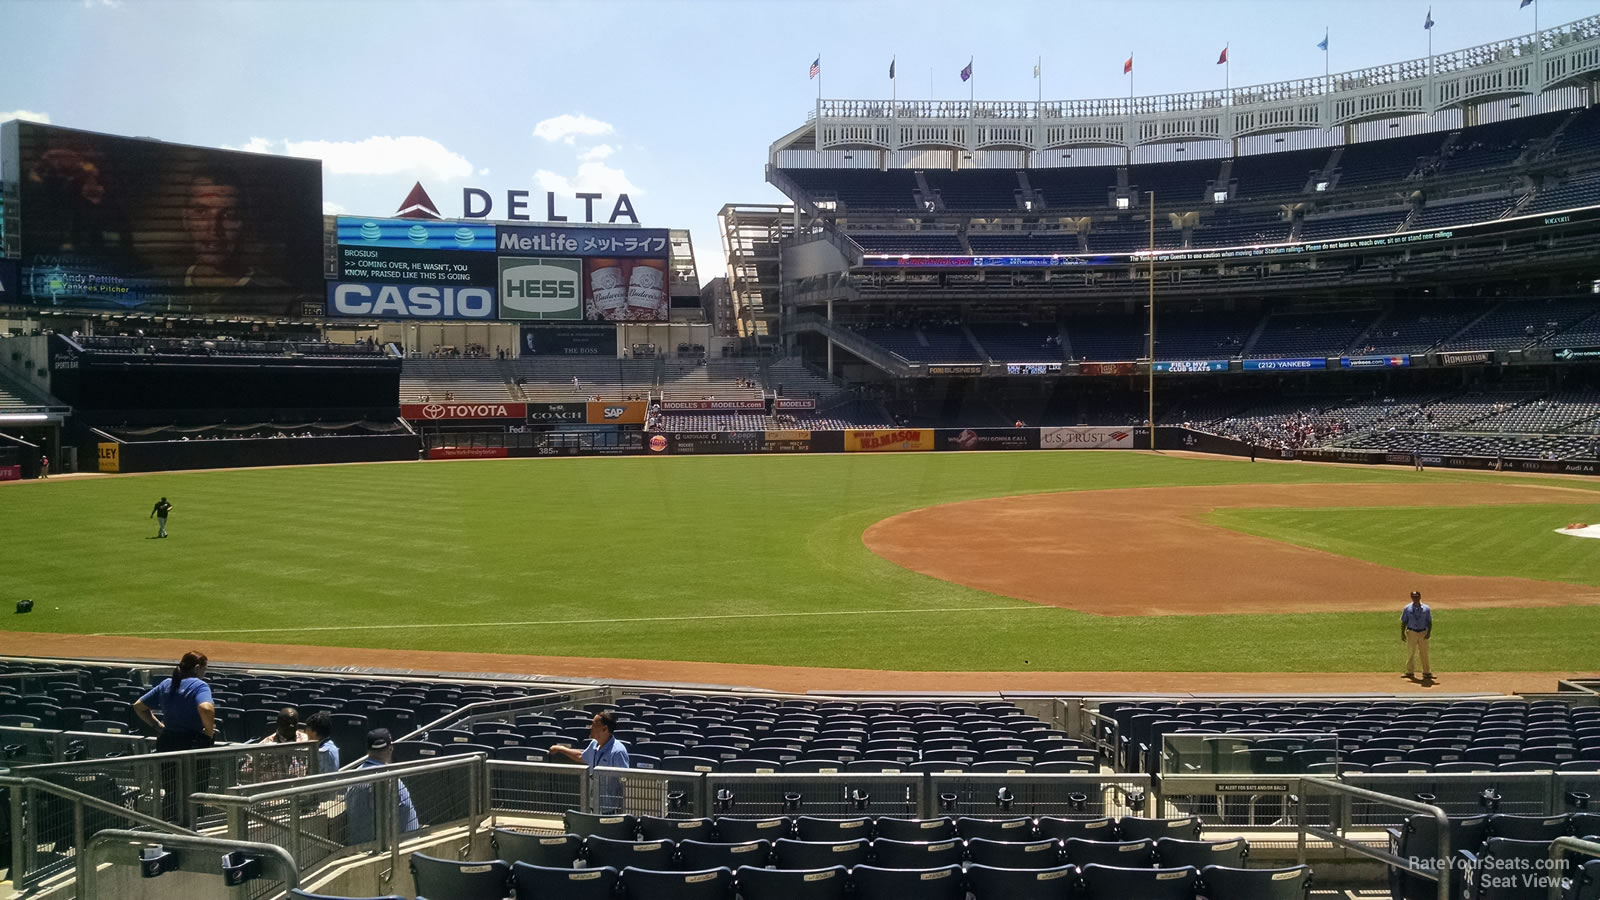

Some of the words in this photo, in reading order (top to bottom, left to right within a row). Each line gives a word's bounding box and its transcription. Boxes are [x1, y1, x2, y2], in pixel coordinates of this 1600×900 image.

[463, 187, 640, 223] DELTA
[1435, 231, 1452, 239] railings
[500, 233, 578, 251] MetLife
[584, 237, 666, 252] メットライフ
[389, 262, 410, 270] OVER,
[423, 263, 451, 272] WASN'T,
[62, 273, 86, 284] Andy
[89, 274, 124, 283] Pettitte
[345, 269, 369, 278] KNOW,
[62, 282, 97, 291] Yankees
[507, 279, 575, 299] HESS
[334, 283, 492, 318] CASIO
[448, 406, 508, 416] TOYOTA
[604, 408, 624, 418] SAP
[1044, 434, 1065, 443] U.S.
[1066, 433, 1105, 442] TRUST
